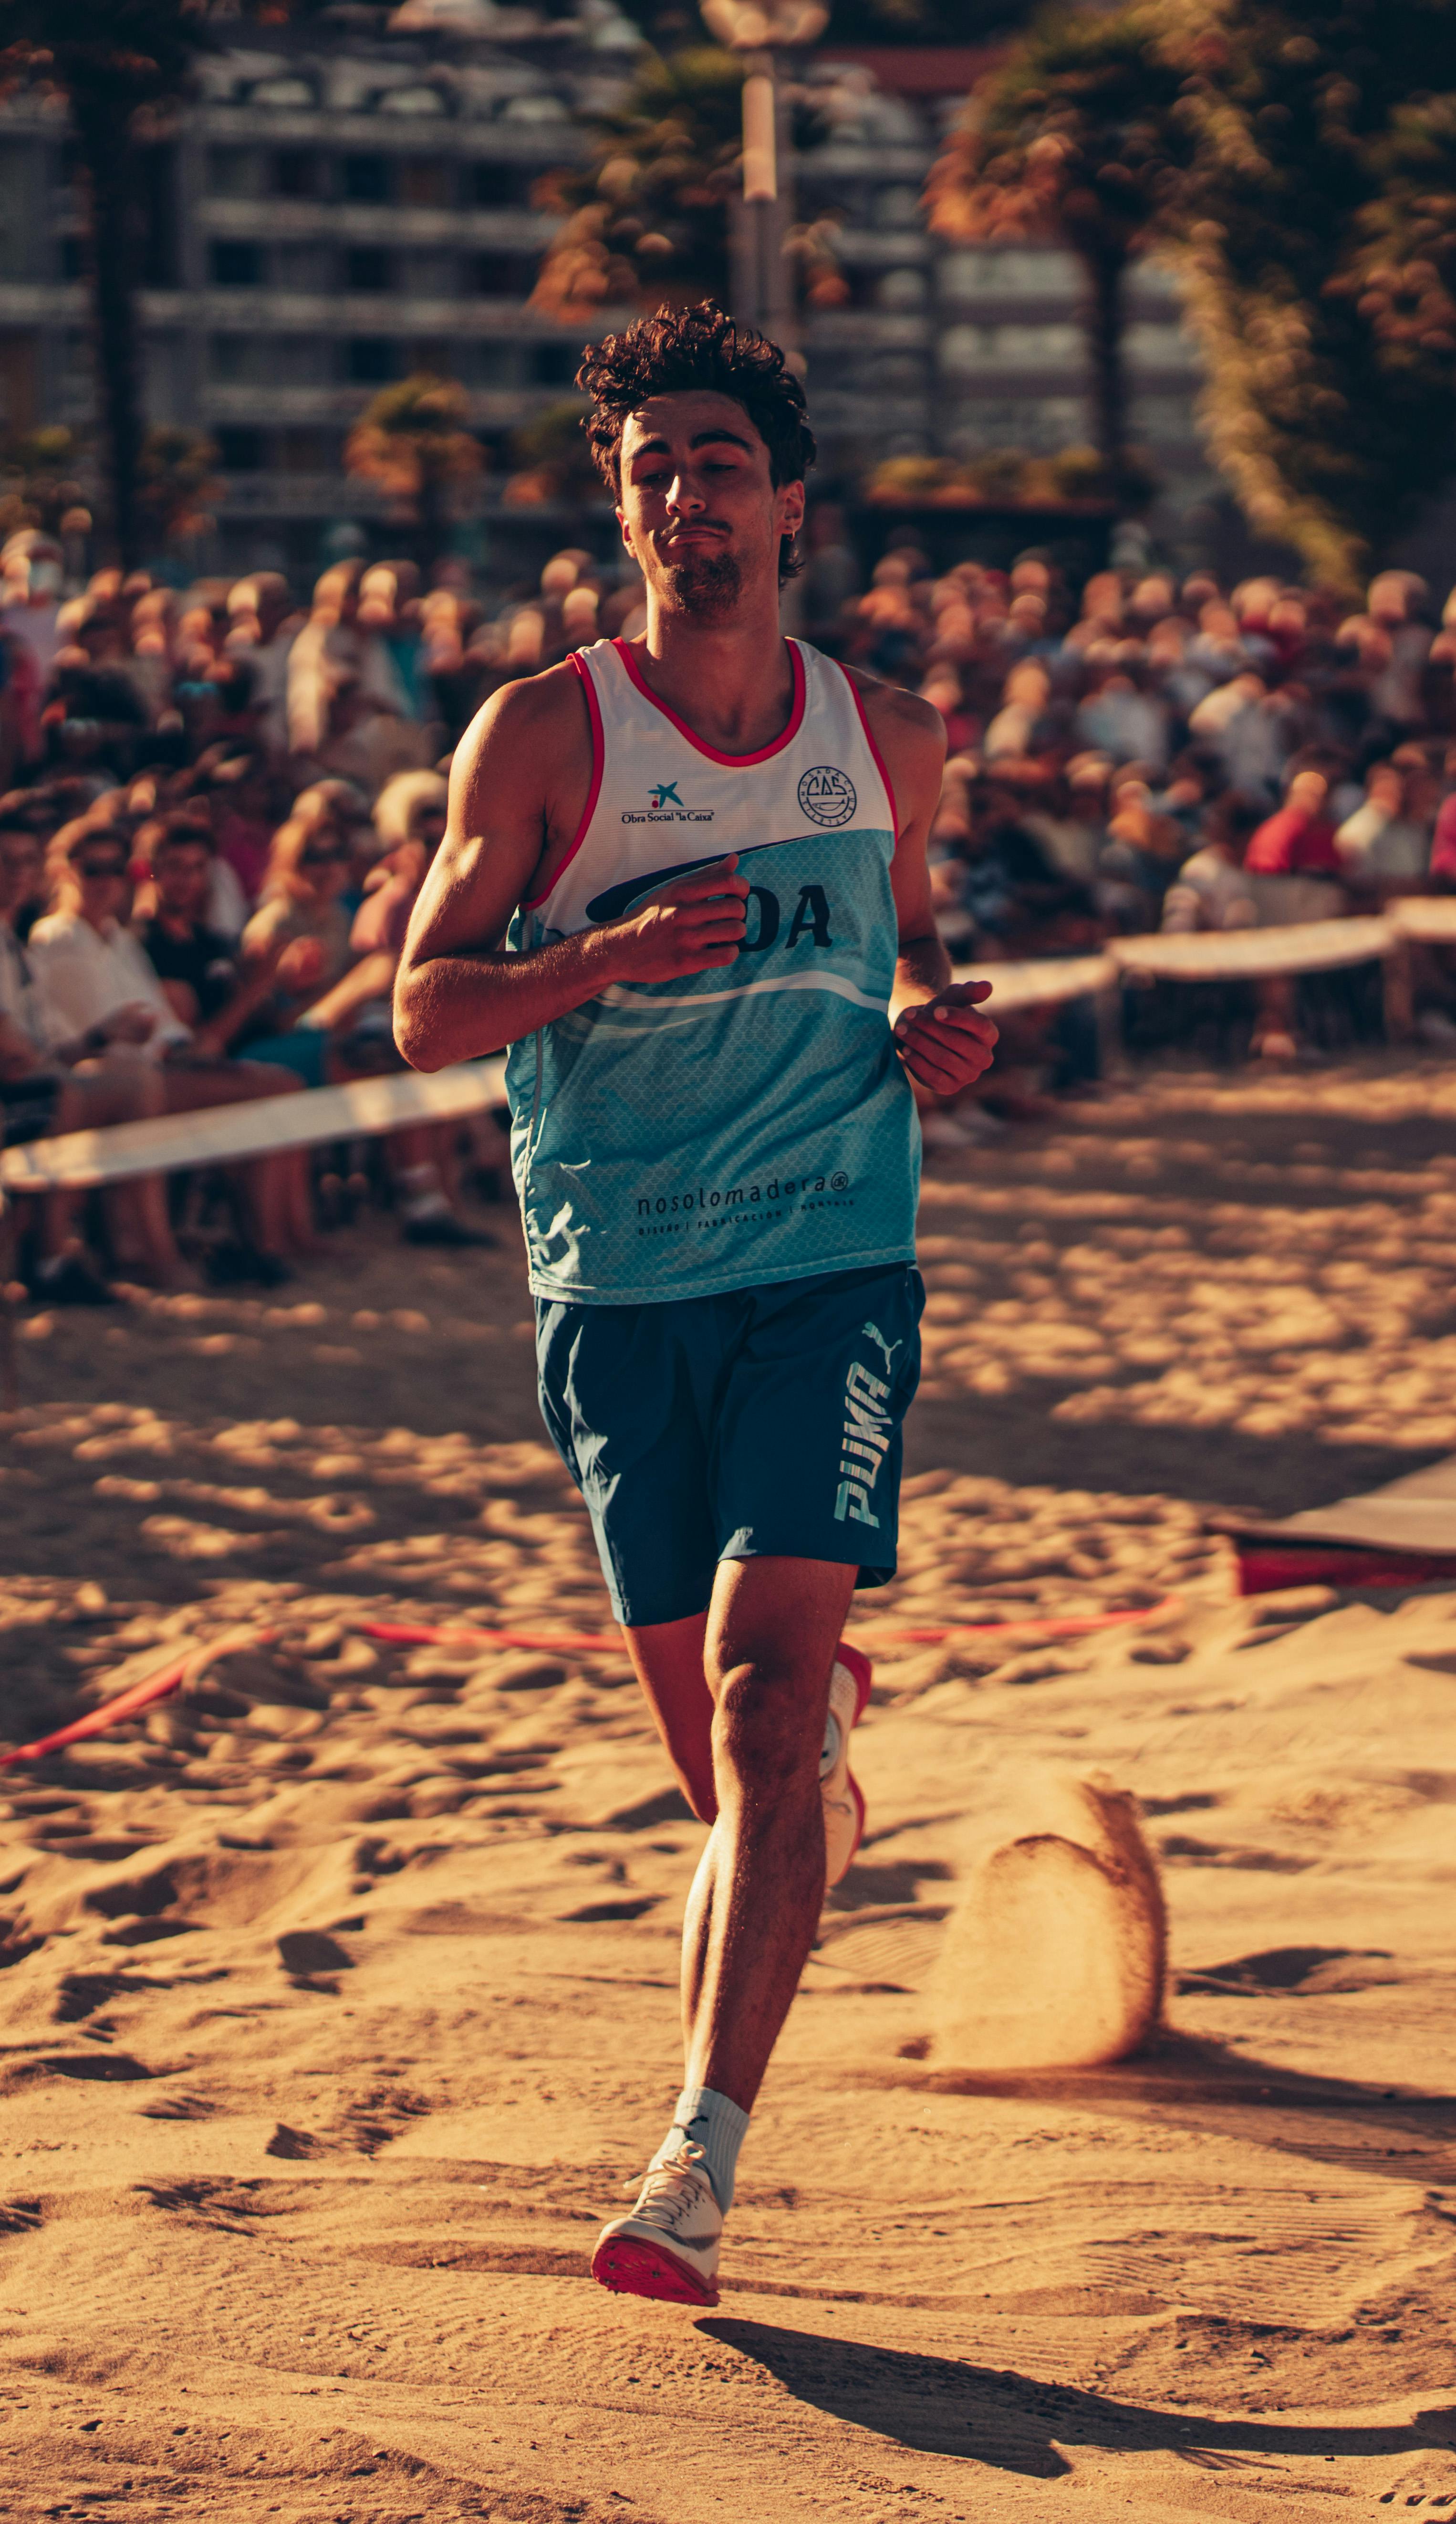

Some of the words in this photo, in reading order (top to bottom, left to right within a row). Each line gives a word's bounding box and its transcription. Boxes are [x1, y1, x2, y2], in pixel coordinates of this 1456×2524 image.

[807, 775, 847, 796] CAS
[622, 814, 645, 824] Obra
[647, 812, 674, 821] Social
[707, 885, 833, 953] DA
[833, 1361, 893, 1529] PUMA
